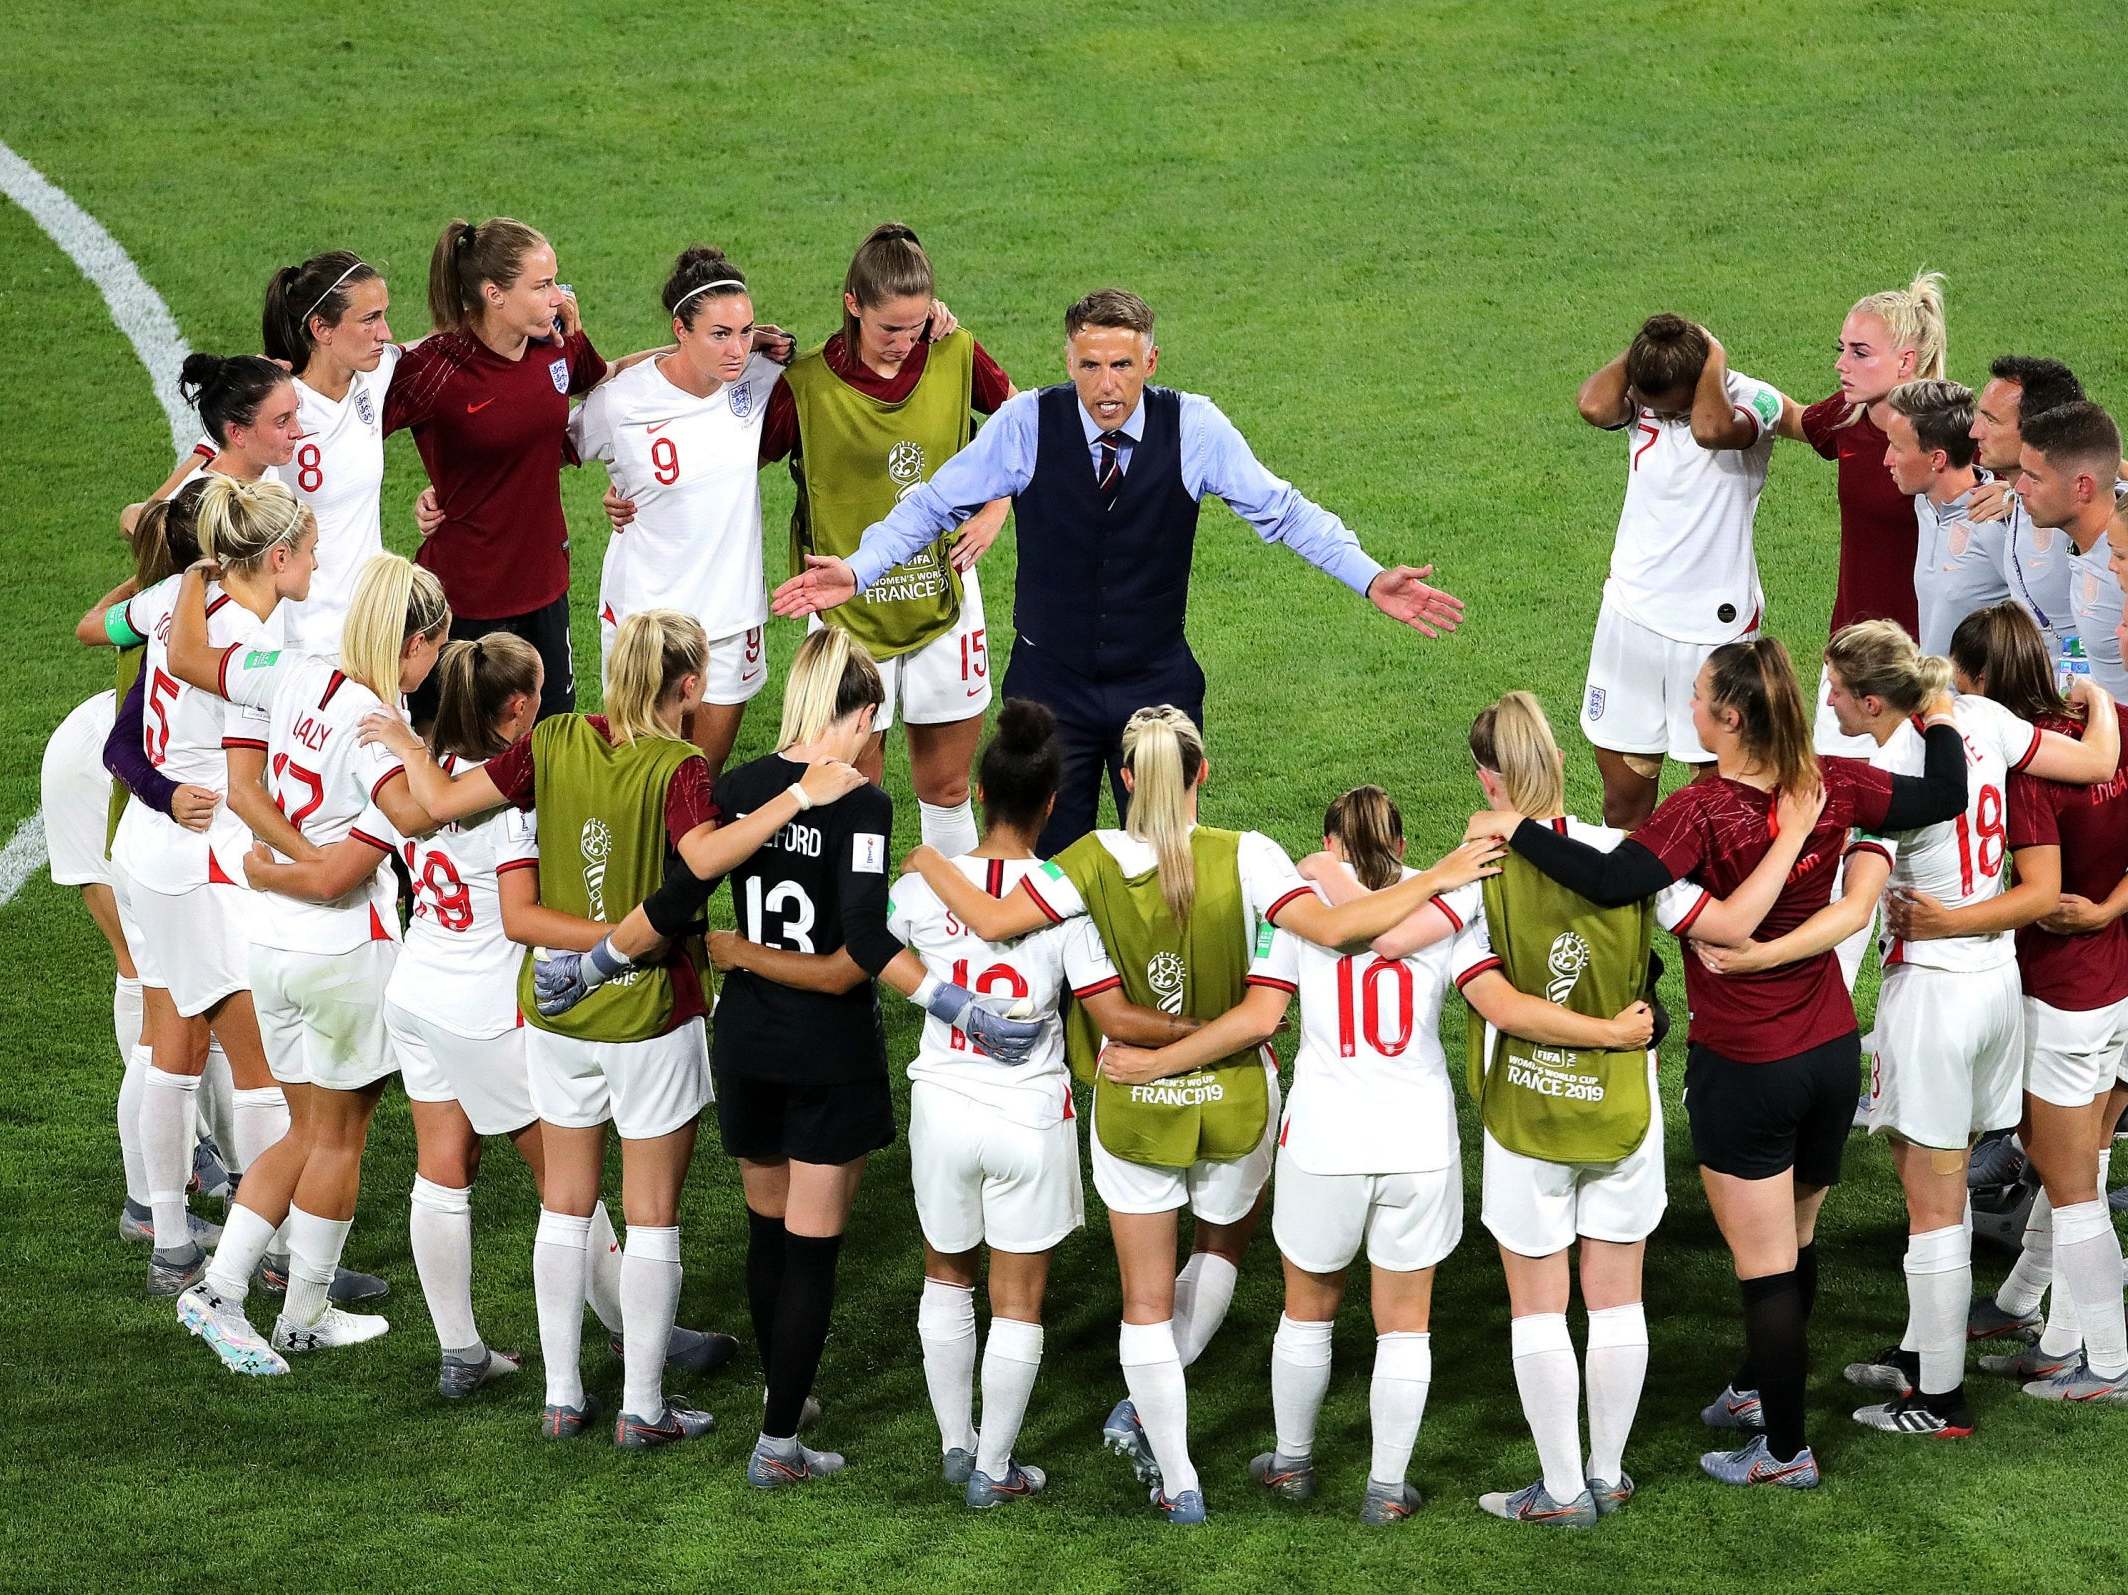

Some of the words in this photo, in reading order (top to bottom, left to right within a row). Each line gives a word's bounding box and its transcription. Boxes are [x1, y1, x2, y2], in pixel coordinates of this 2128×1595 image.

[297, 443, 323, 493] 8
[651, 437, 680, 486] 9
[1637, 422, 1660, 472] 7
[864, 580, 938, 605] FRANCE
[961, 629, 987, 681] 15
[146, 666, 180, 768] 5
[1956, 783, 2006, 897] 18
[745, 875, 815, 955] 13
[1337, 954, 1414, 1057] 10
[1537, 1049, 1561, 1064] FIFA
[1544, 1068, 1577, 1083] WORLD
[1578, 1075, 1599, 1085] CUP
[1507, 1065, 1564, 1097] RANCE
[1564, 1082, 1605, 1102] 2019
